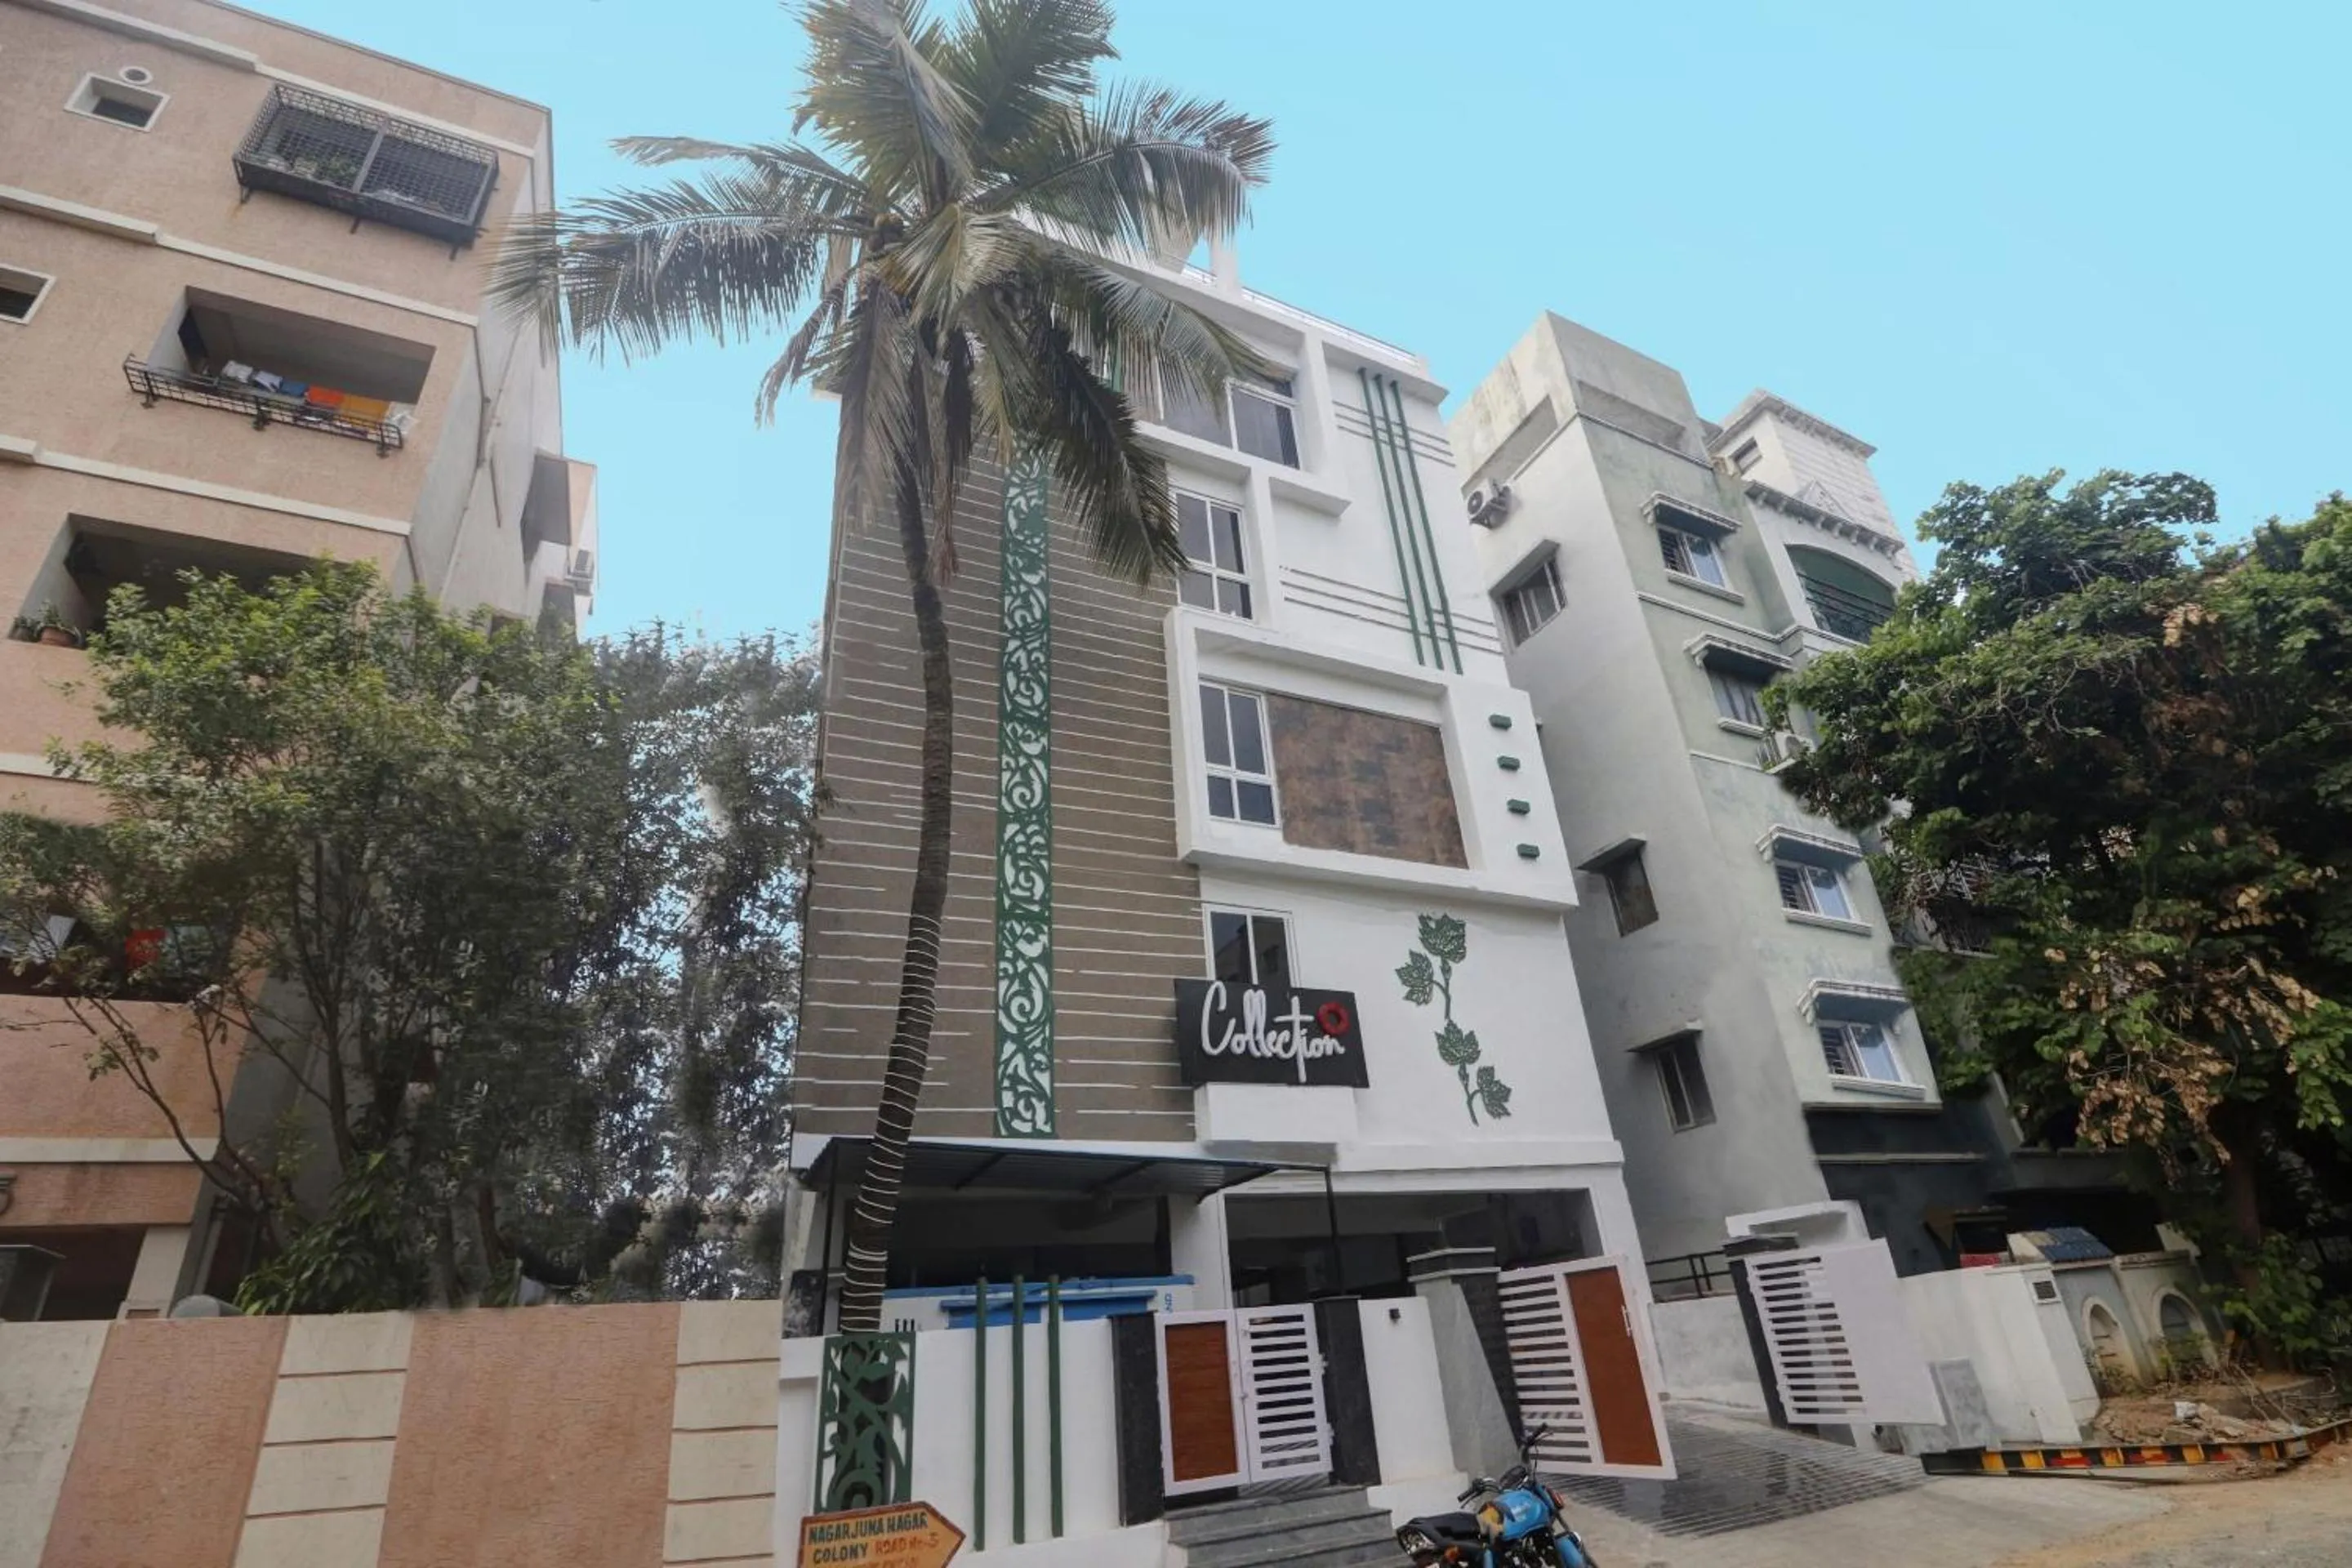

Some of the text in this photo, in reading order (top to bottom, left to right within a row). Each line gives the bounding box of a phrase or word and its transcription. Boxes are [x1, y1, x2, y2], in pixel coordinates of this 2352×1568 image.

[1200, 981, 1345, 1082] Collection
[813, 1542, 869, 1564] COLONY
[873, 1537, 908, 1555] ROAD
